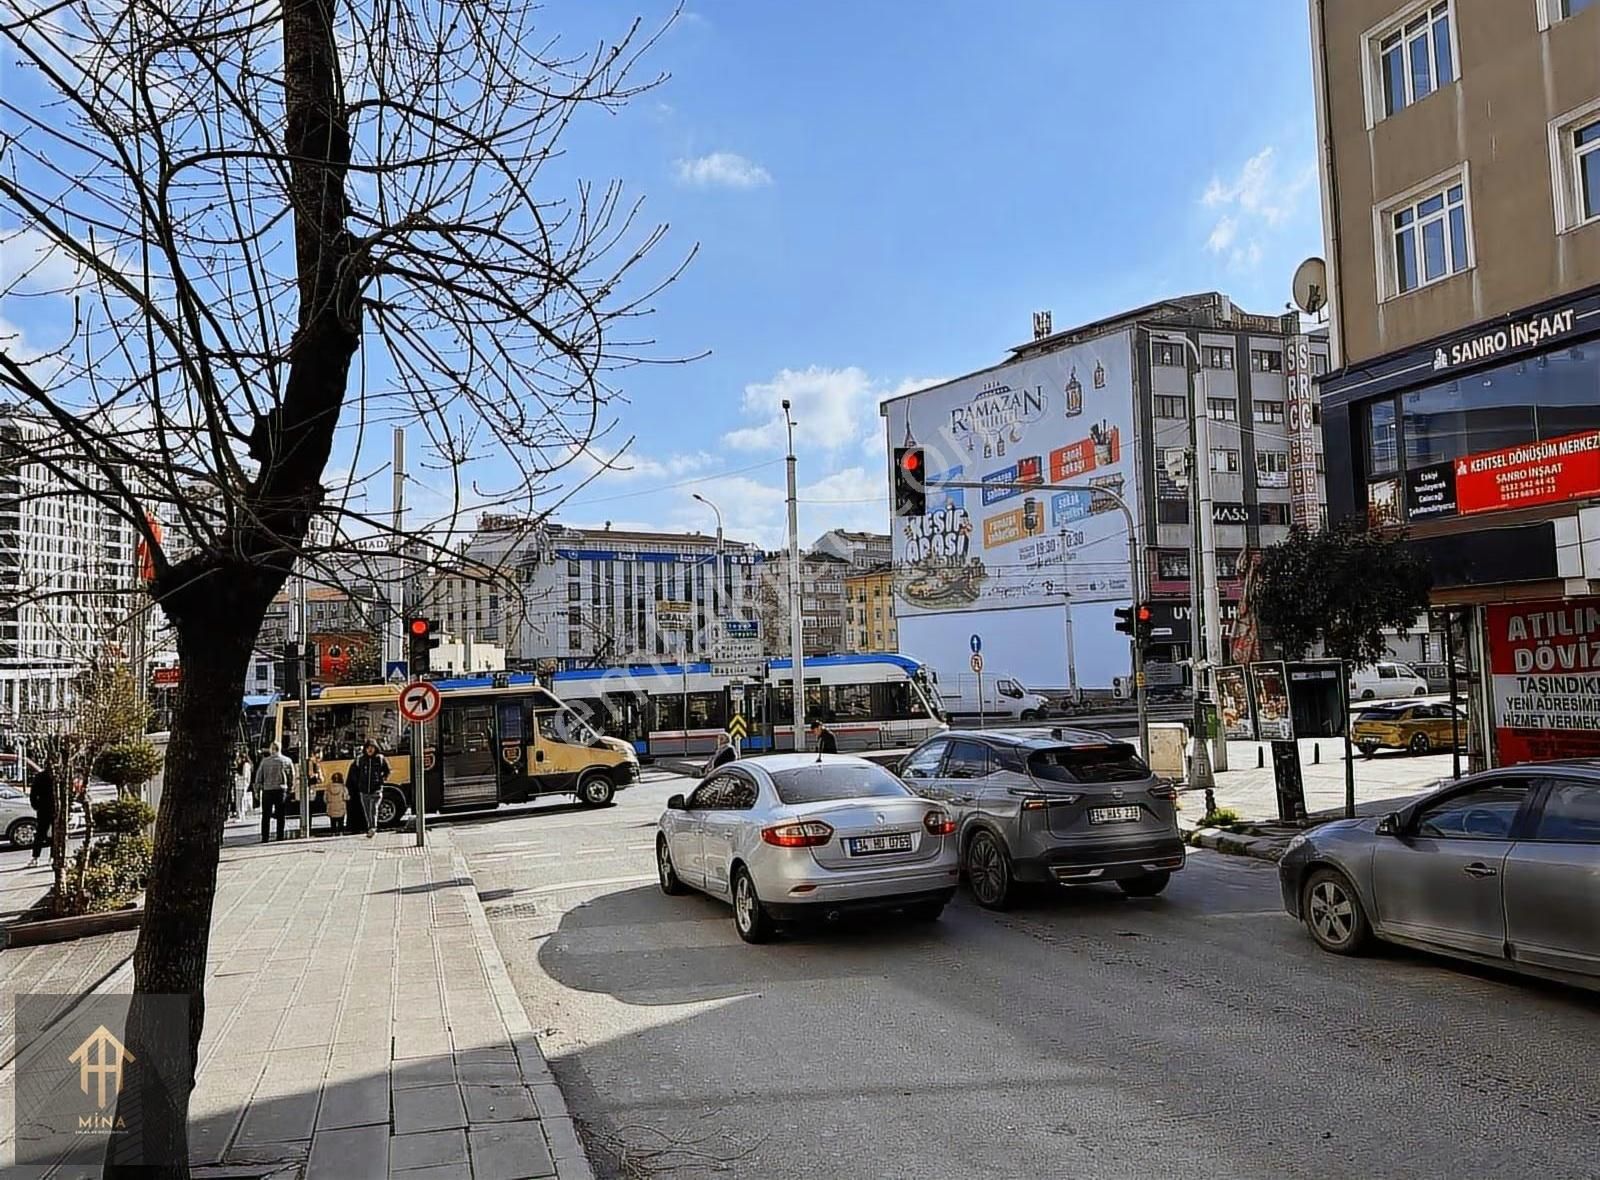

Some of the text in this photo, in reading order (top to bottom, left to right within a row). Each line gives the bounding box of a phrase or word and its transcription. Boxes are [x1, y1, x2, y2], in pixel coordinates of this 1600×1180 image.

[1451, 308, 1574, 365] SANRO İNŞAAT
[950, 386, 1043, 434] RAMAZAN
[1470, 455, 1508, 473] KENTSEL
[1509, 442, 1558, 465] DÖNÜŞÜM
[1495, 462, 1563, 484] SANRO İNŞAAT
[1505, 694, 1534, 711] YENİ
[1502, 711, 1546, 728] HİZMET
